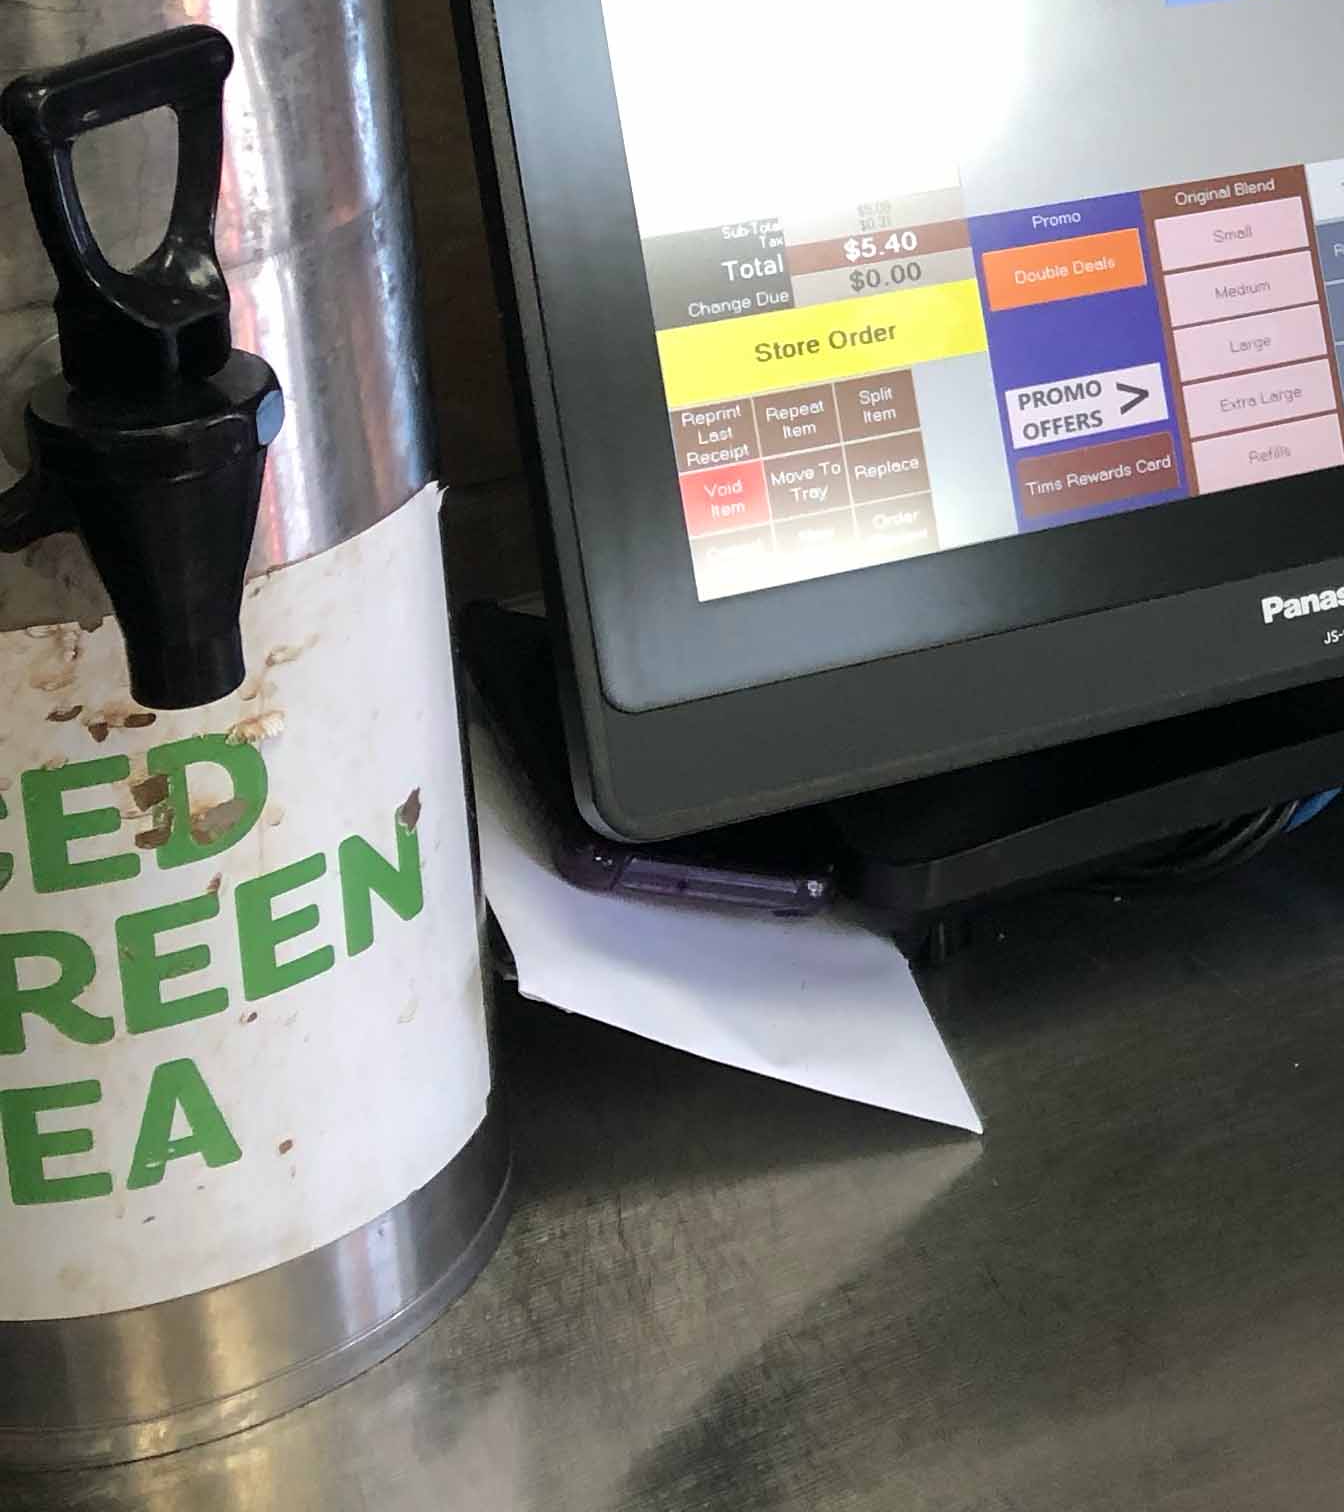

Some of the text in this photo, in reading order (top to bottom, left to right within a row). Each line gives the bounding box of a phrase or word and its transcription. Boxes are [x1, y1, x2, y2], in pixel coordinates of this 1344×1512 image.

[1174, 178, 1276, 210] Original Blend
[1032, 210, 1082, 230] Promo
[759, 235, 784, 250] Tax
[1213, 224, 1253, 244] Small
[721, 232, 918, 281] Total $5.40
[1015, 255, 1116, 285] Double Deals
[688, 262, 922, 318] Change Due $0.00
[1214, 279, 1272, 301] Medium
[755, 323, 897, 364] Store Order
[1229, 335, 1272, 355] Large
[859, 386, 894, 407] Split
[1018, 380, 1102, 411] PROMO
[1219, 385, 1303, 414] Extra Large
[681, 405, 743, 428] Reprint
[765, 400, 826, 424] Repeat
[862, 406, 897, 424] Item
[697, 426, 735, 446] Last
[782, 420, 817, 439] Item
[1022, 410, 1104, 442] OFFERS
[685, 443, 750, 467] Receipt
[1247, 444, 1292, 466] Refills
[771, 461, 842, 488] Move To
[854, 456, 920, 481] Replace
[1026, 455, 1172, 497] Tims Rewards Card
[703, 479, 744, 499] Void
[789, 483, 829, 503] Tray
[710, 499, 746, 520] Item
[0, 733, 268, 895] ED
